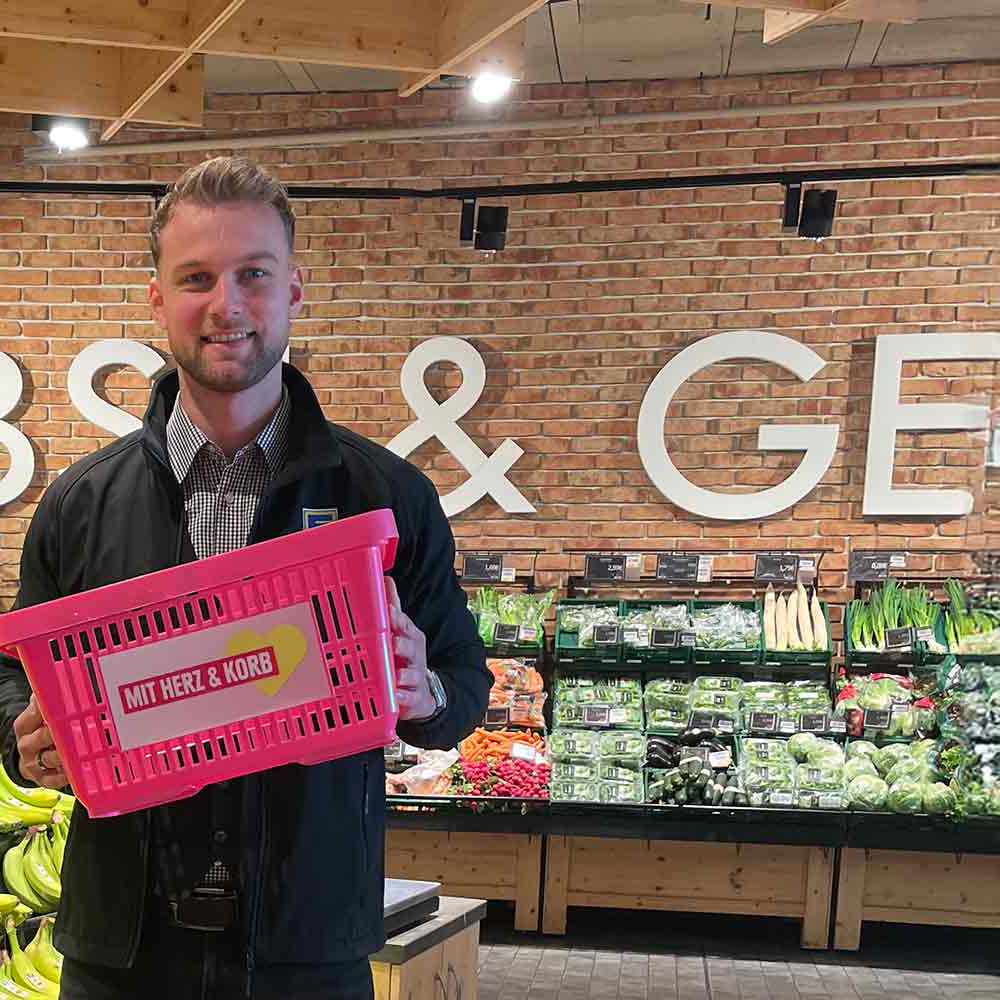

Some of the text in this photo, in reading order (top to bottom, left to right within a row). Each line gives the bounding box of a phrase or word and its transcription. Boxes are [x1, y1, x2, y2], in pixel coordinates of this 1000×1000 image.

[386, 336, 538, 518] &
[637, 331, 1000, 520] GE
[123, 651, 273, 710] MIT HERZ & KORB
